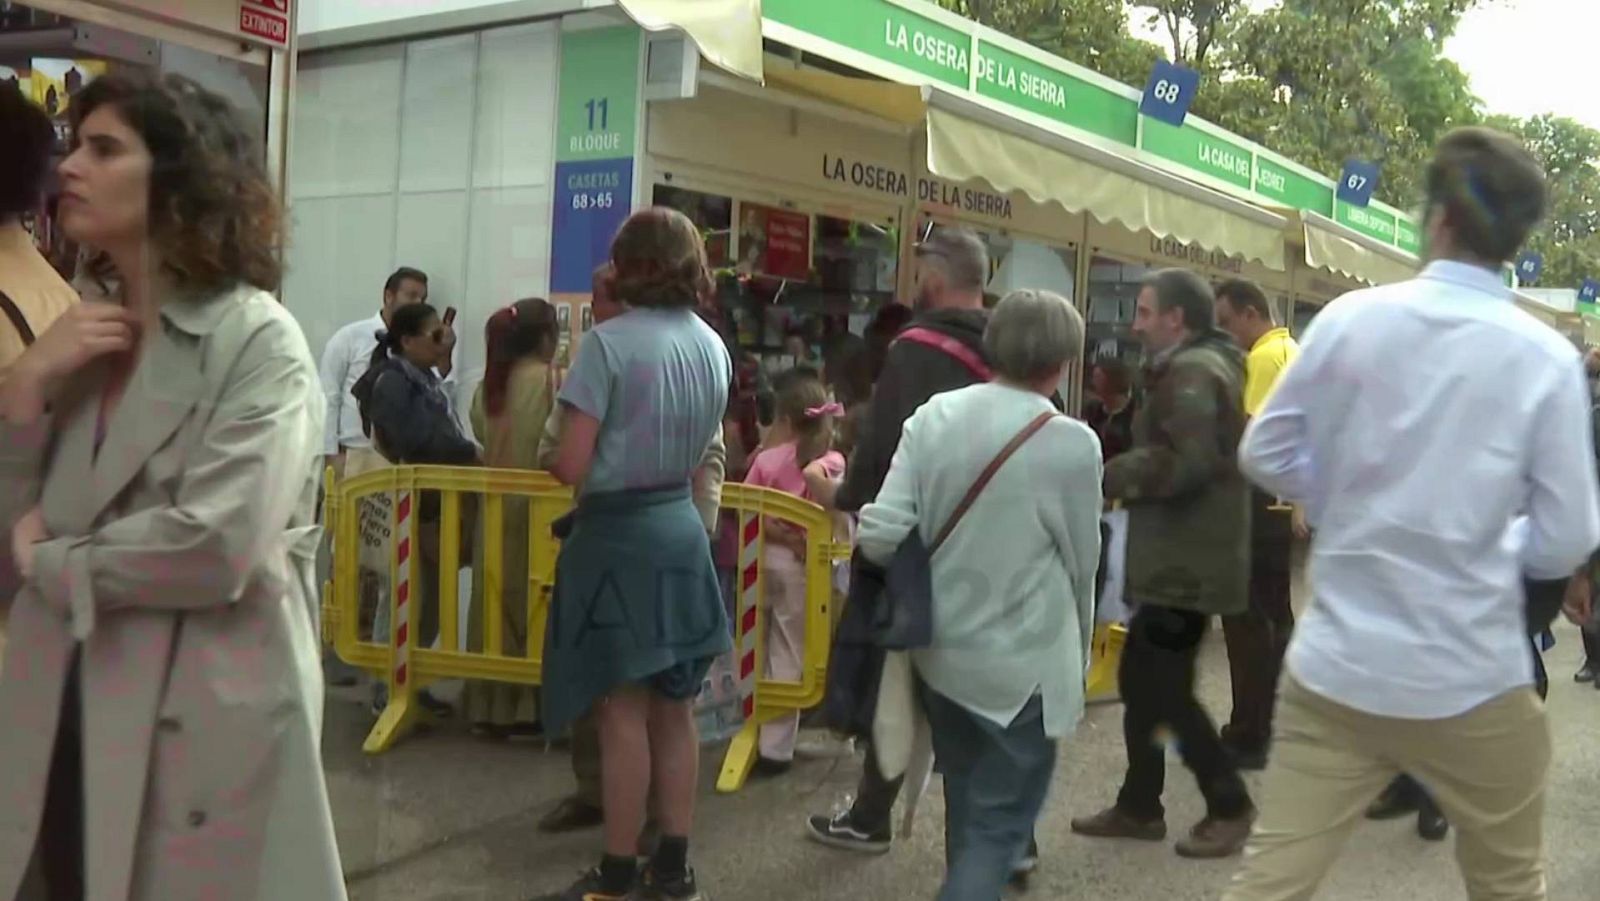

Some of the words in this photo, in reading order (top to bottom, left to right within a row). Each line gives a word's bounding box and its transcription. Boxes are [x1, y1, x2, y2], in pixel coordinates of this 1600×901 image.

[242, 11, 285, 39] EXTINTOR
[885, 19, 909, 53] LA
[912, 31, 969, 75] OSERA
[977, 54, 995, 83] DE
[997, 63, 1017, 92] LA
[1019, 71, 1067, 109] SIERRA
[1154, 79, 1180, 105] 68
[585, 98, 607, 130] 11
[570, 133, 620, 153] BLOQUE
[1198, 142, 1211, 164] LA
[1211, 147, 1235, 174] CASA
[1235, 157, 1250, 179] DEL
[568, 171, 618, 190] CASETAS
[823, 153, 846, 182] LA
[851, 161, 908, 197] OSERA
[918, 178, 939, 203] DE
[942, 184, 961, 209] LA
[964, 189, 1013, 219] SIERRA
[1347, 173, 1368, 192] 67
[572, 192, 613, 209] 68>65
